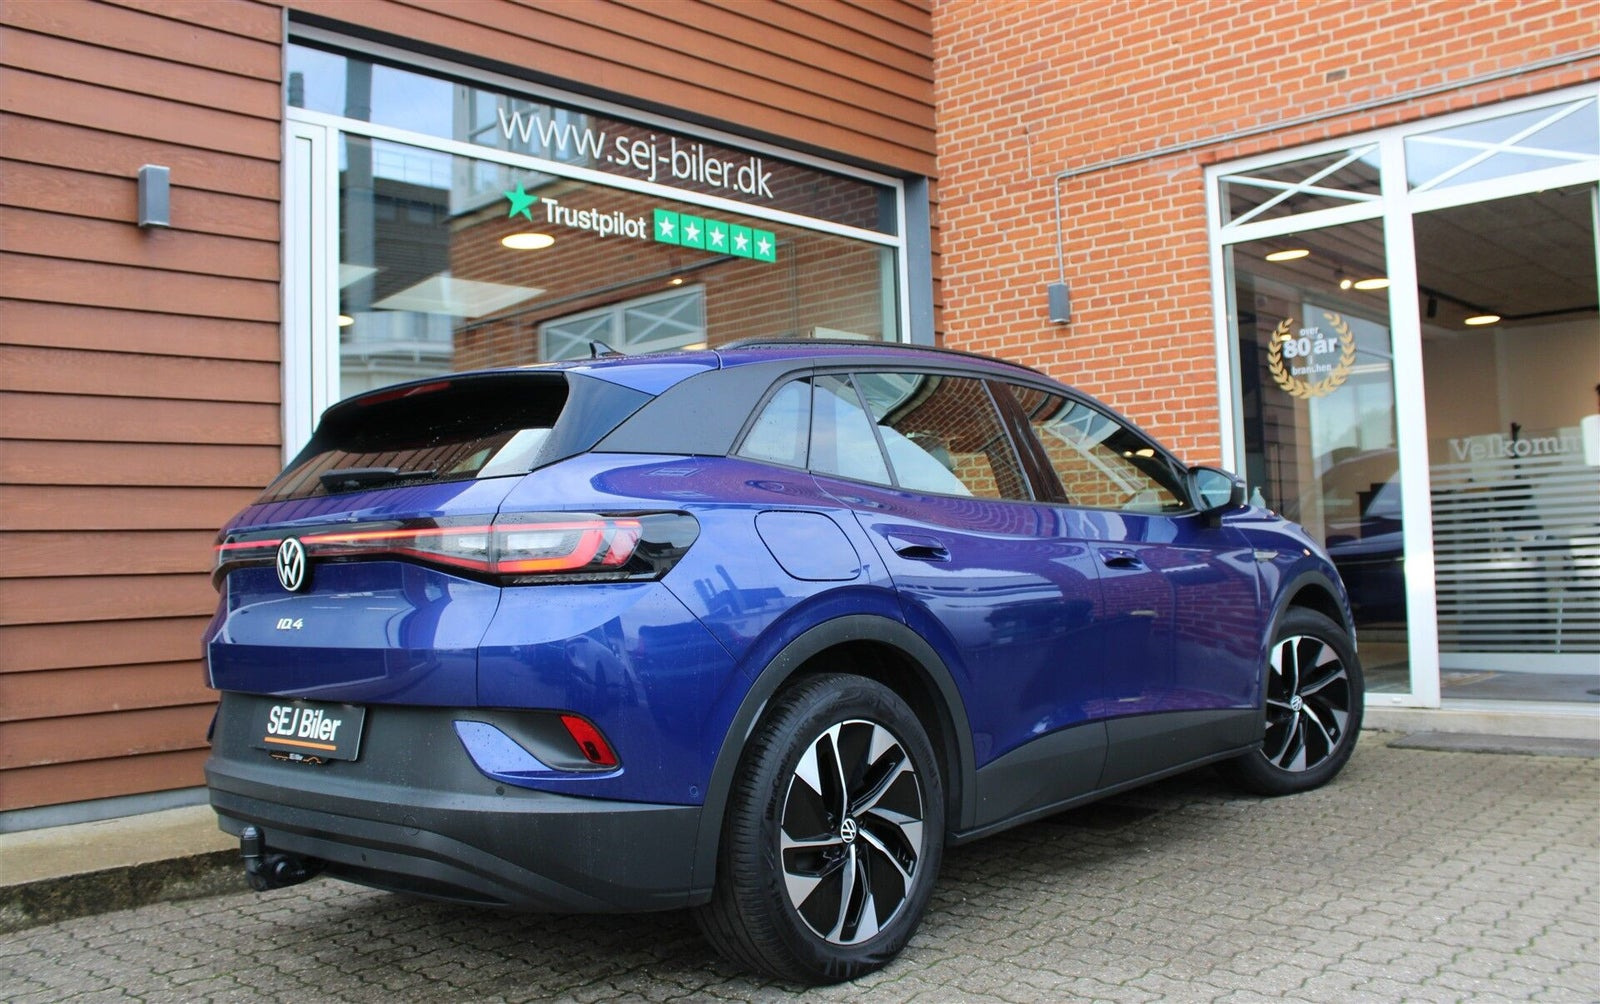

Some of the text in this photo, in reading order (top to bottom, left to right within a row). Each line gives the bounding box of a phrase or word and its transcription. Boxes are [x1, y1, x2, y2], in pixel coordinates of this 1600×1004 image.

[498, 107, 774, 199] www.sej-biler.dk
[541, 197, 647, 239] Trustpilot
[1283, 332, 1338, 358] 80 år
[1299, 327, 1320, 336] over
[1291, 363, 1332, 376] branchen
[266, 704, 342, 742] SEJ Biler
